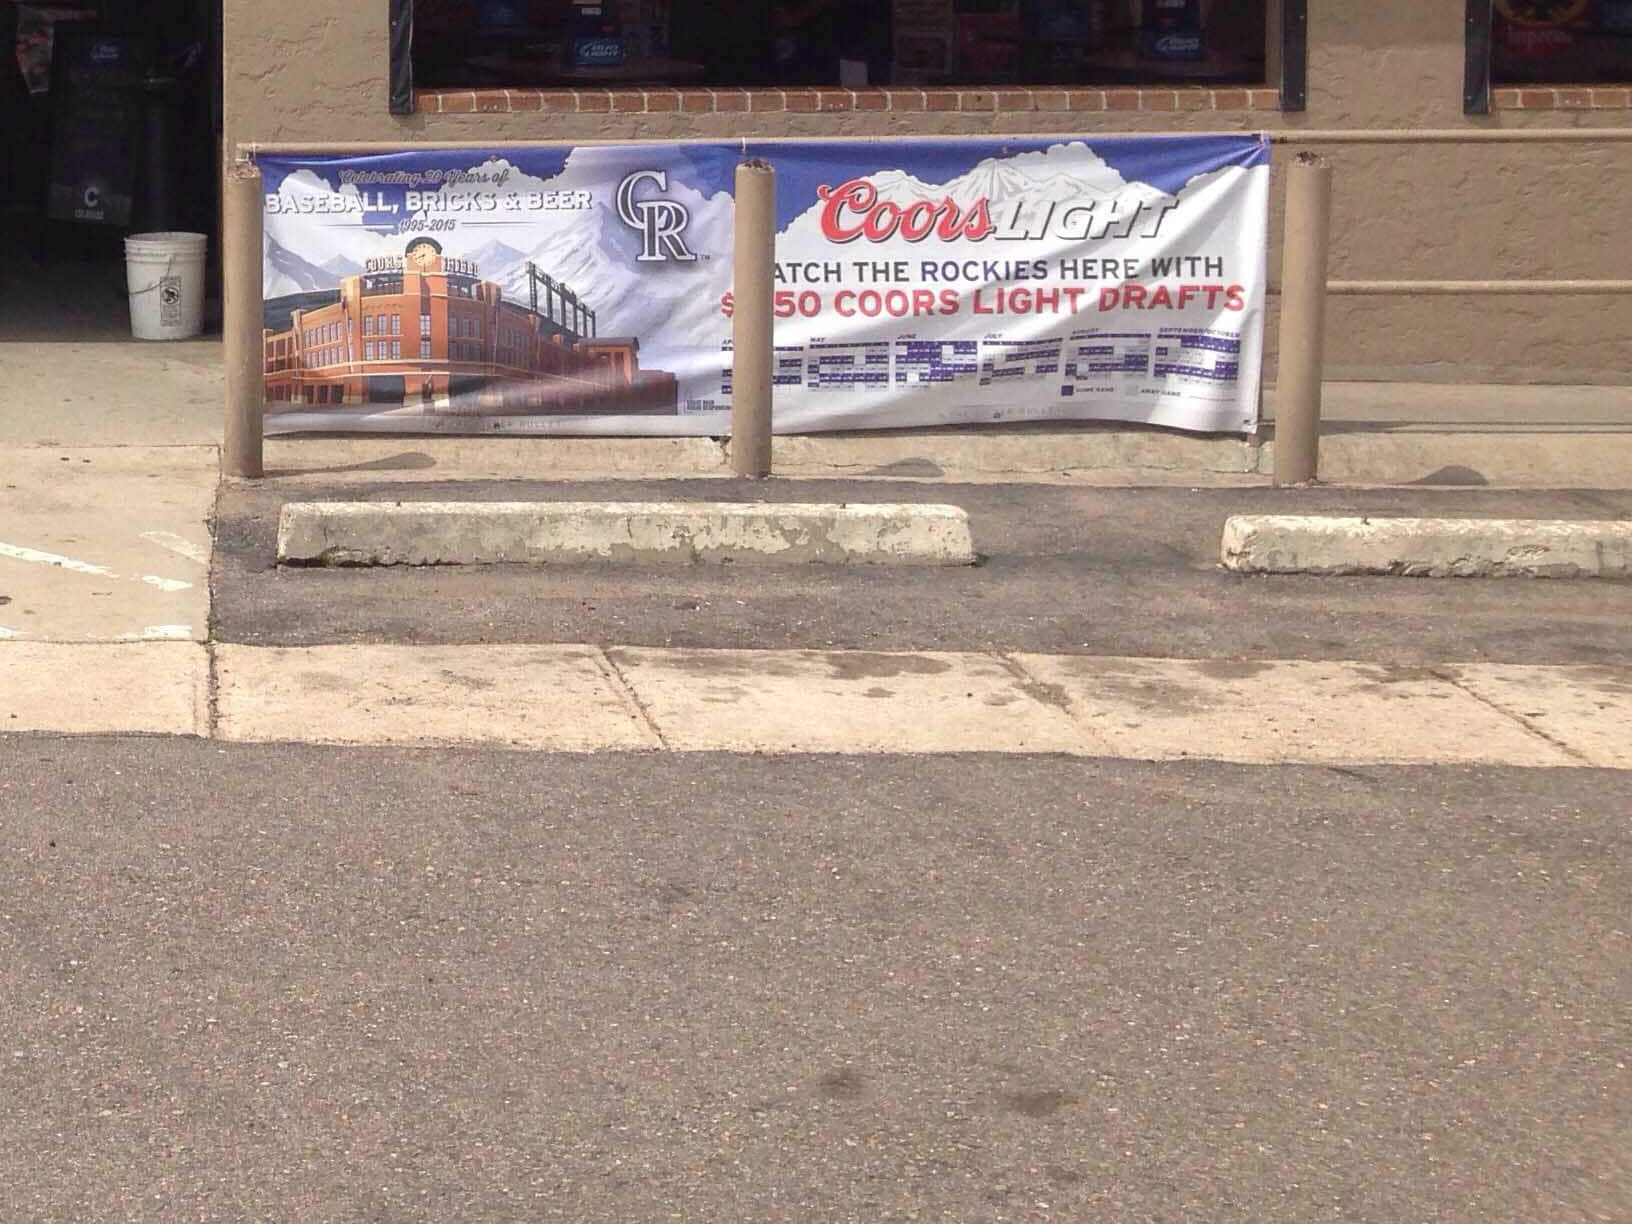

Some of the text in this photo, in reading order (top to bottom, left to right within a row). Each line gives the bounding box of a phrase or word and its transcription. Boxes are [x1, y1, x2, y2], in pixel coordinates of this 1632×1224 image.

[338, 168, 419, 187] Celebrating
[491, 167, 510, 187] of
[264, 189, 593, 214] BASEBALL, BRICKS & BEER
[817, 178, 1180, 244] Coors LIGHT
[399, 218, 457, 232] 1995-2015
[773, 256, 1224, 283] ATCH THE ROCKIES HERE WITH
[833, 288, 961, 318] COORS
[972, 285, 1085, 315] LIGHT
[1097, 284, 1246, 313] DRAFTS
